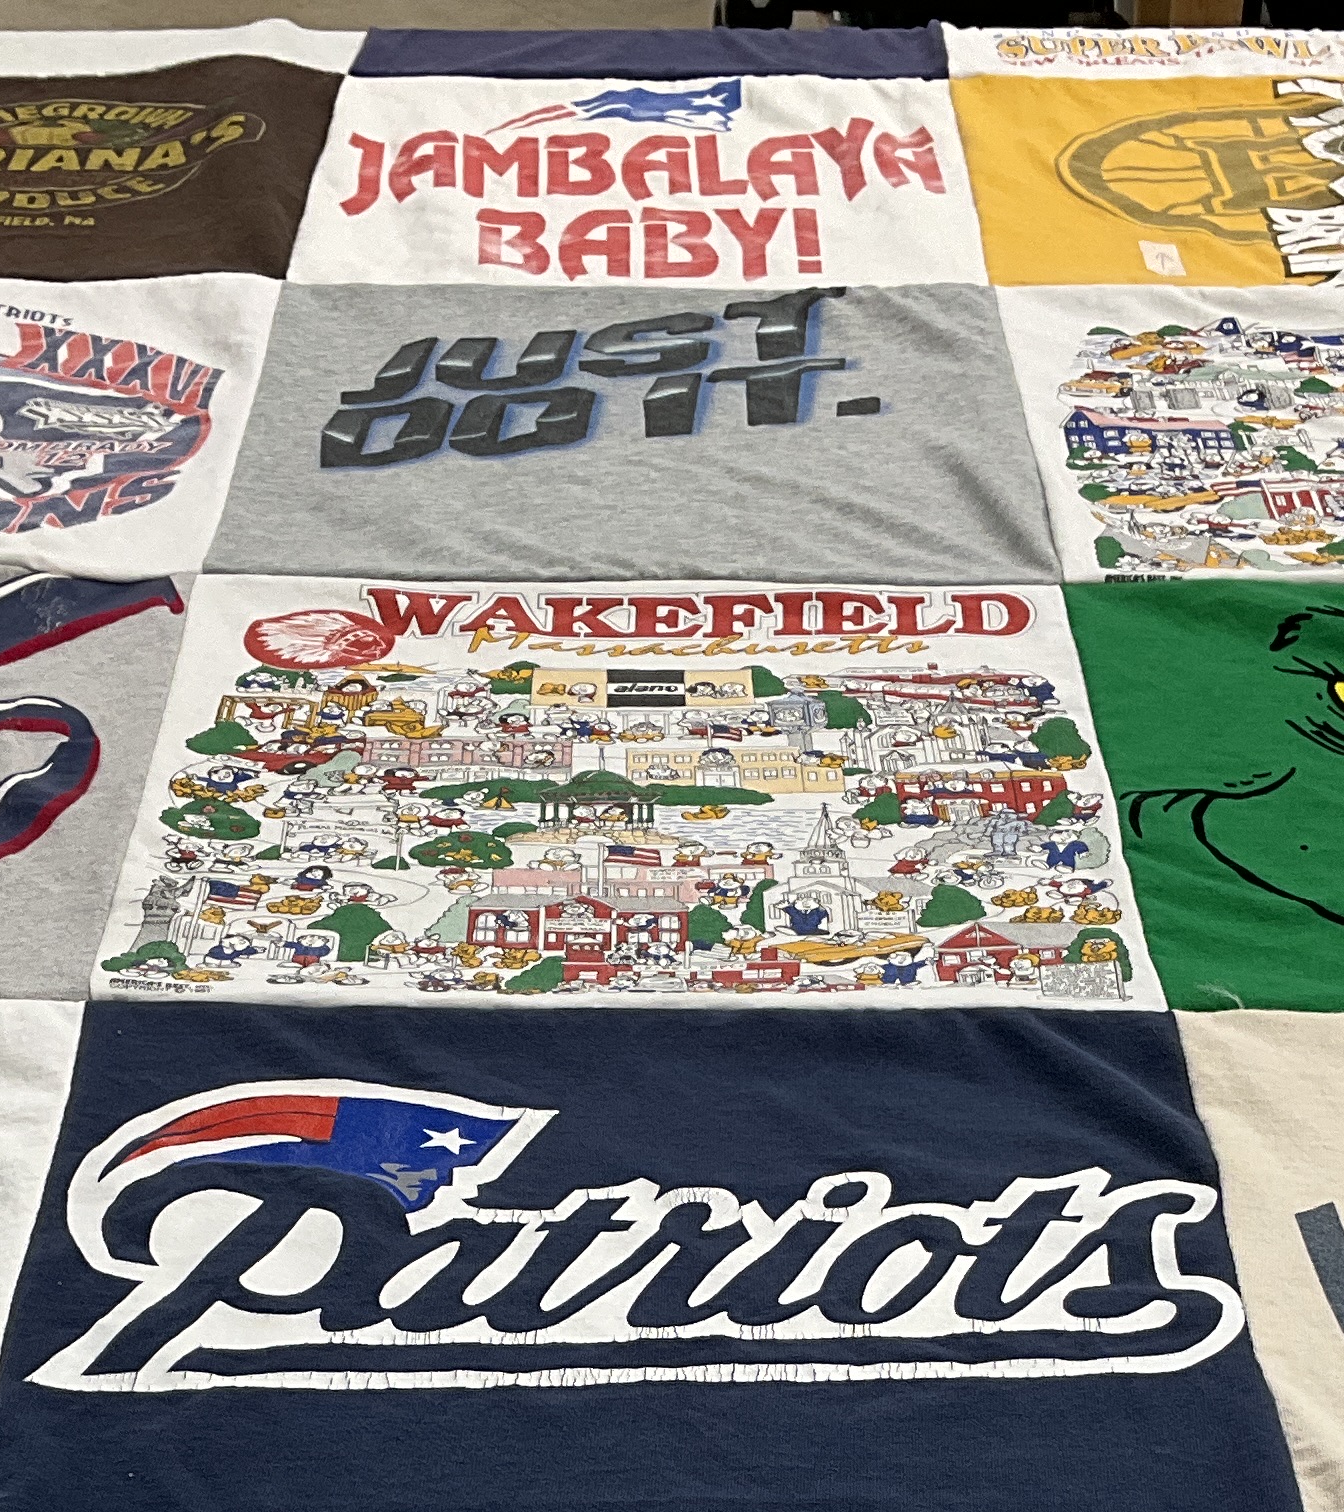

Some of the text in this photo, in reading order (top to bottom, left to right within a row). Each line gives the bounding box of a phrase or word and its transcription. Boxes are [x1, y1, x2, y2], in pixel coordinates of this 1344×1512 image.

[996, 34, 1171, 59] SUPER
[339, 117, 947, 217] JAMBALAYA
[475, 206, 824, 282] BABY!
[340, 285, 849, 407] JUST
[318, 385, 602, 470] DO
[360, 584, 1038, 639] WAKEFIELD
[467, 627, 931, 657] Massachusetts
[24, 1125, 1246, 1394] Patriots
